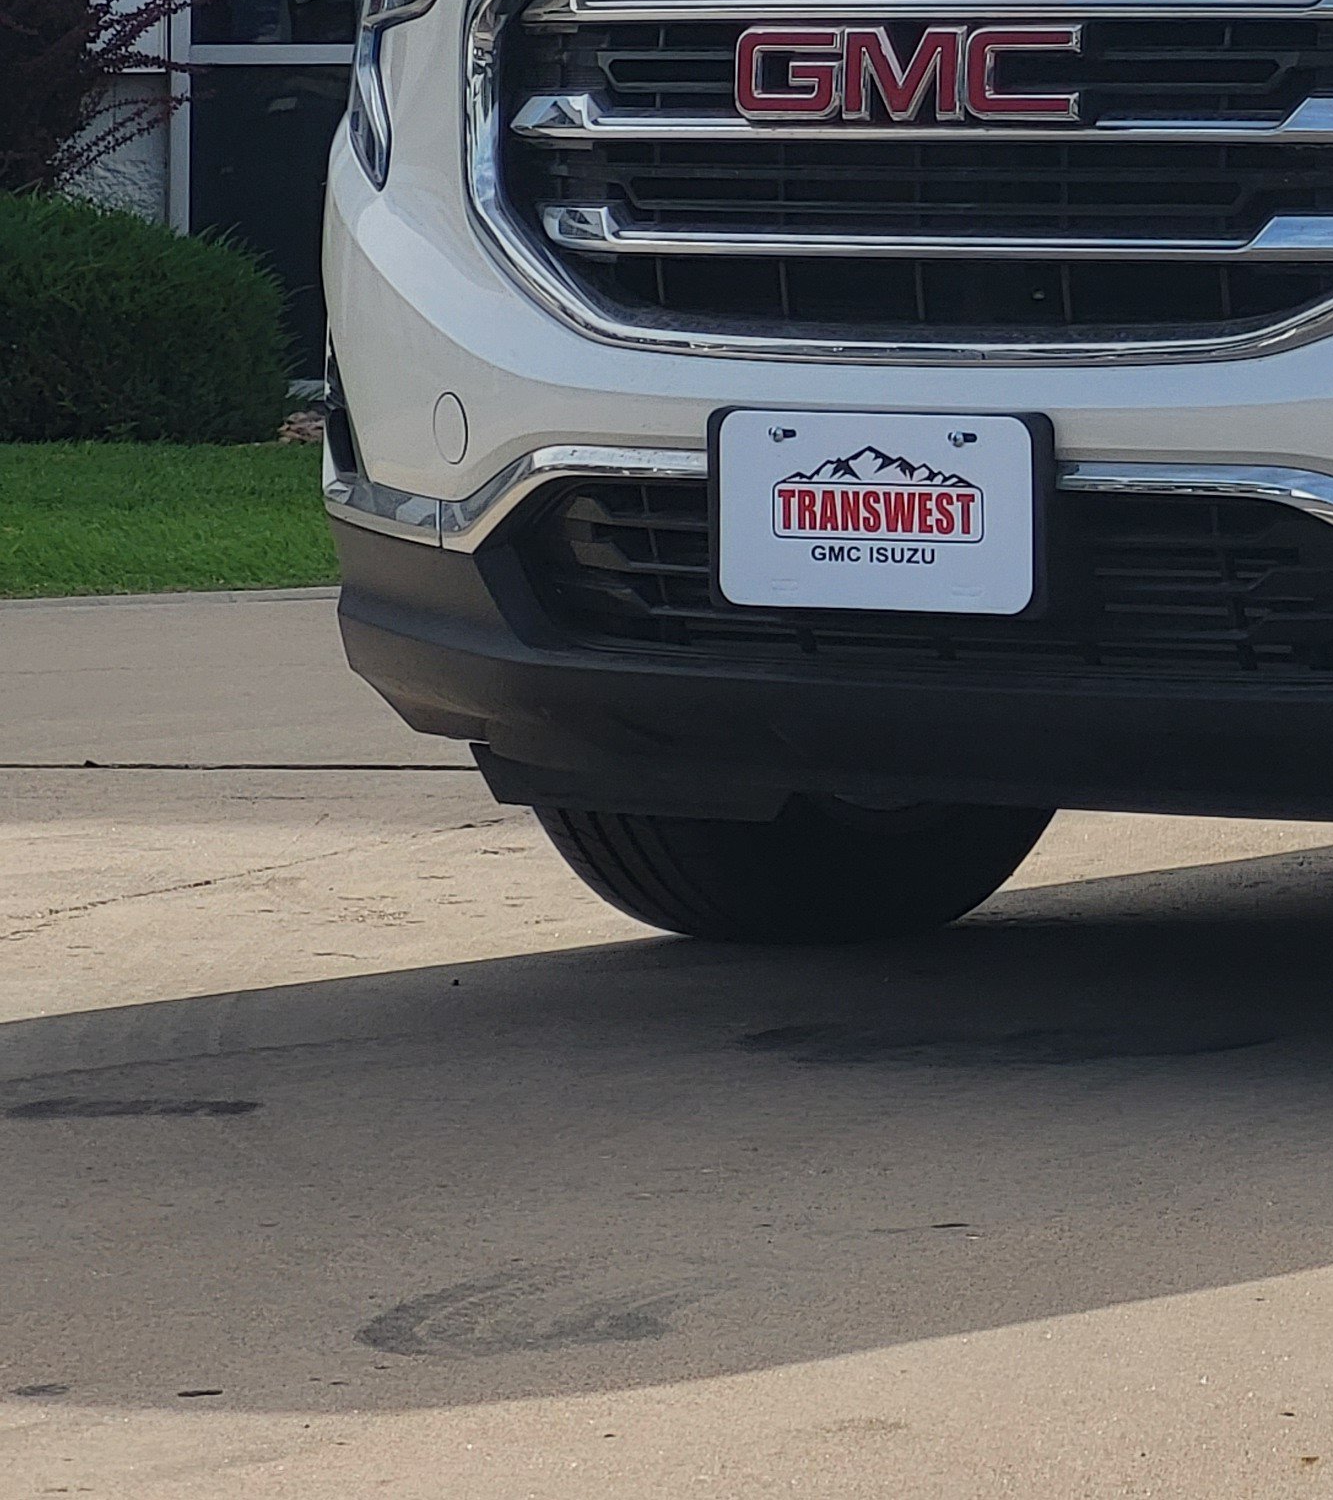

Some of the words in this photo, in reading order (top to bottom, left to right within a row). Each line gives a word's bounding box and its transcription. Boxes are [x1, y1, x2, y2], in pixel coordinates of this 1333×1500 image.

[735, 25, 1083, 122] GMC
[777, 488, 976, 536] TRANSWEST
[810, 545, 862, 563] GMC
[869, 546, 936, 565] ISUZU
